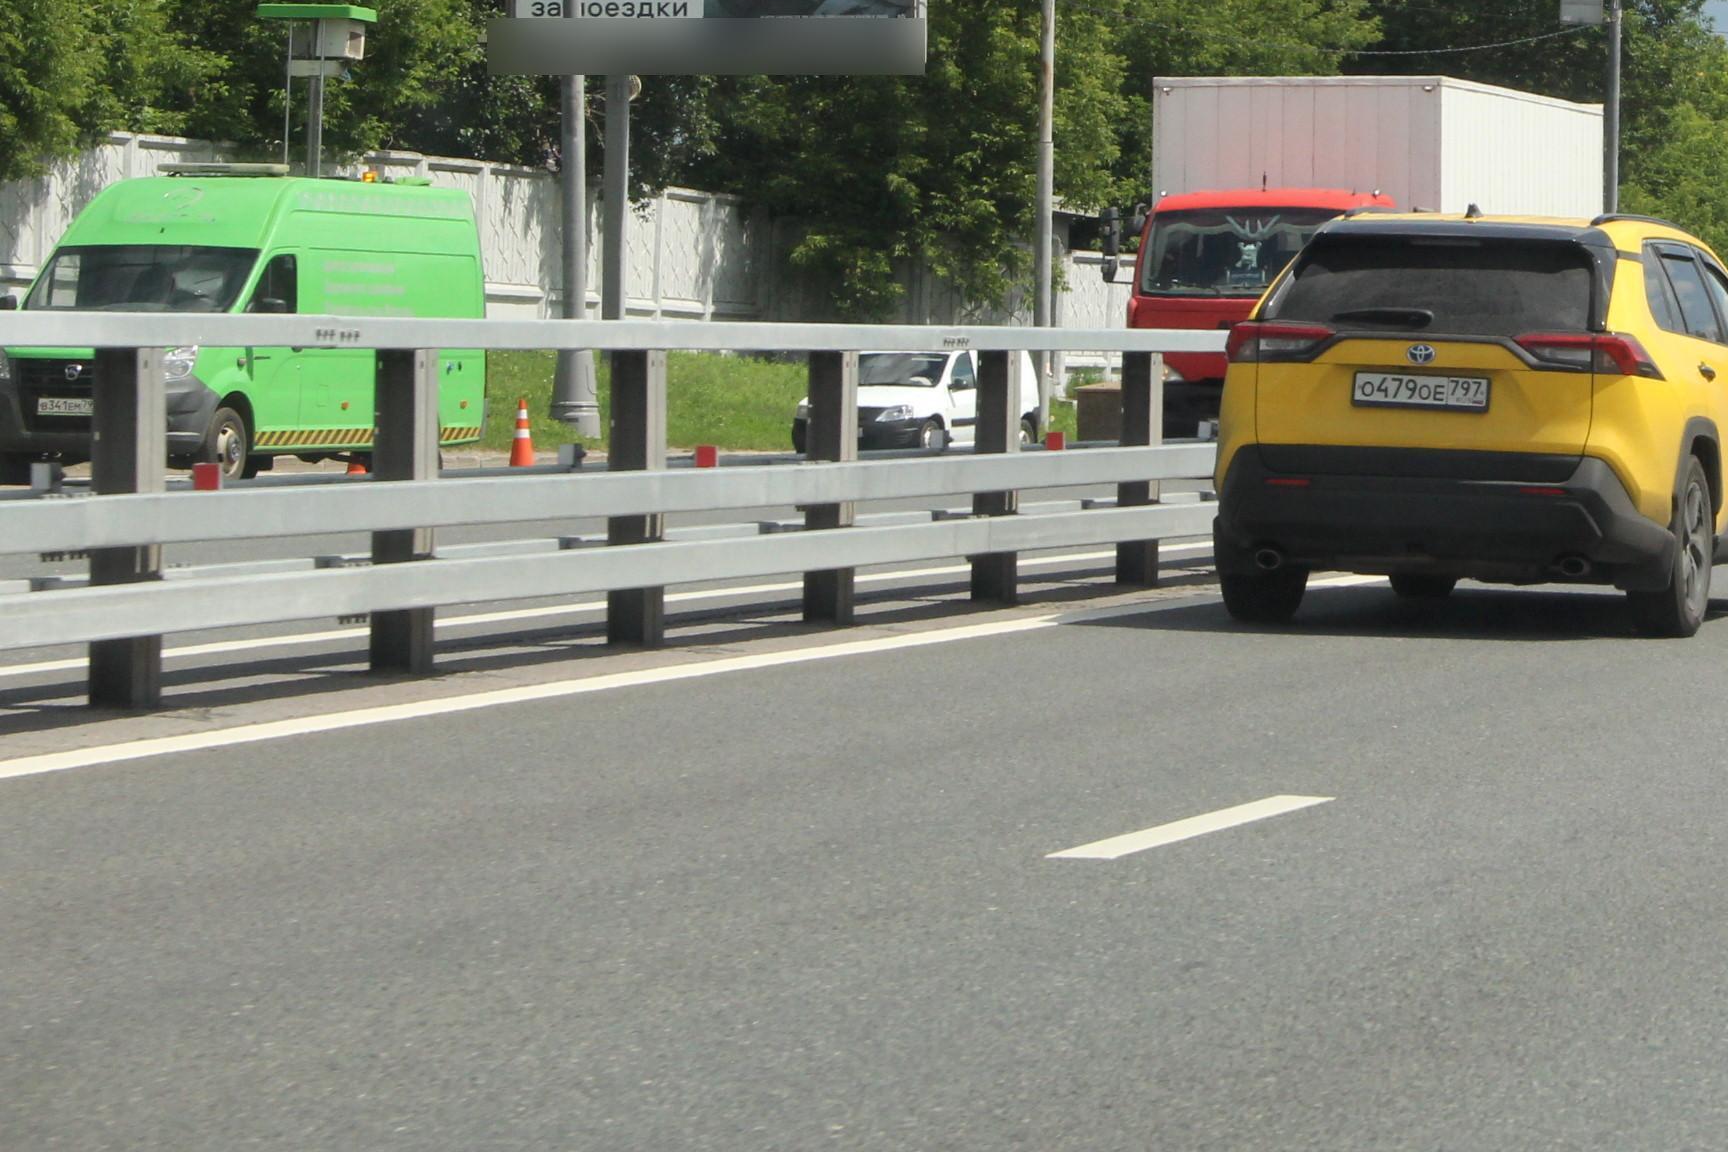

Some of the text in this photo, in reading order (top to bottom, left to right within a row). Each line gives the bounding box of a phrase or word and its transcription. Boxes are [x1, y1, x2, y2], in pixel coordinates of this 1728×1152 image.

[531, 1, 688, 18] за оездки
[1450, 379, 1482, 398] 797
